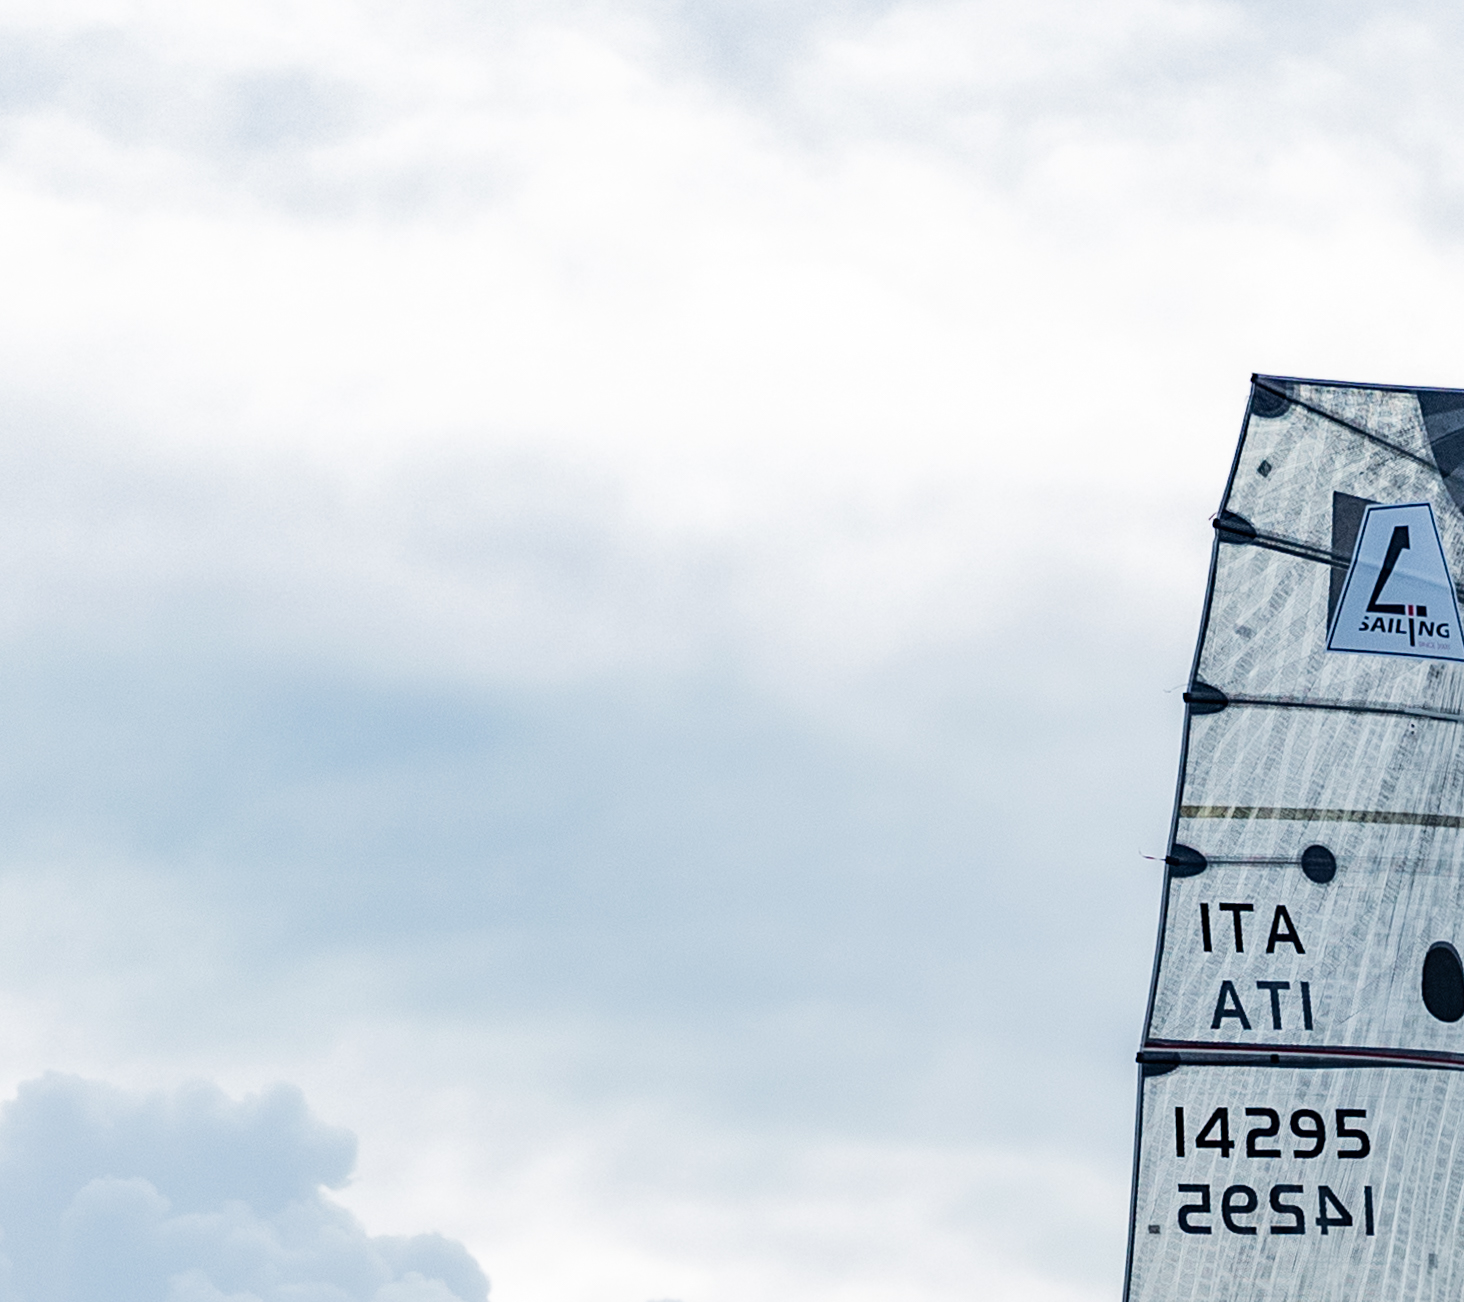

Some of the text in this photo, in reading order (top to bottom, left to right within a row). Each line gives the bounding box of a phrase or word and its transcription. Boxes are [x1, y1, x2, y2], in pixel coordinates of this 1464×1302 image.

[1358, 615, 1451, 648] SAILING
[1199, 902, 1306, 954] ITA
[1174, 1106, 1371, 1159] 14295
